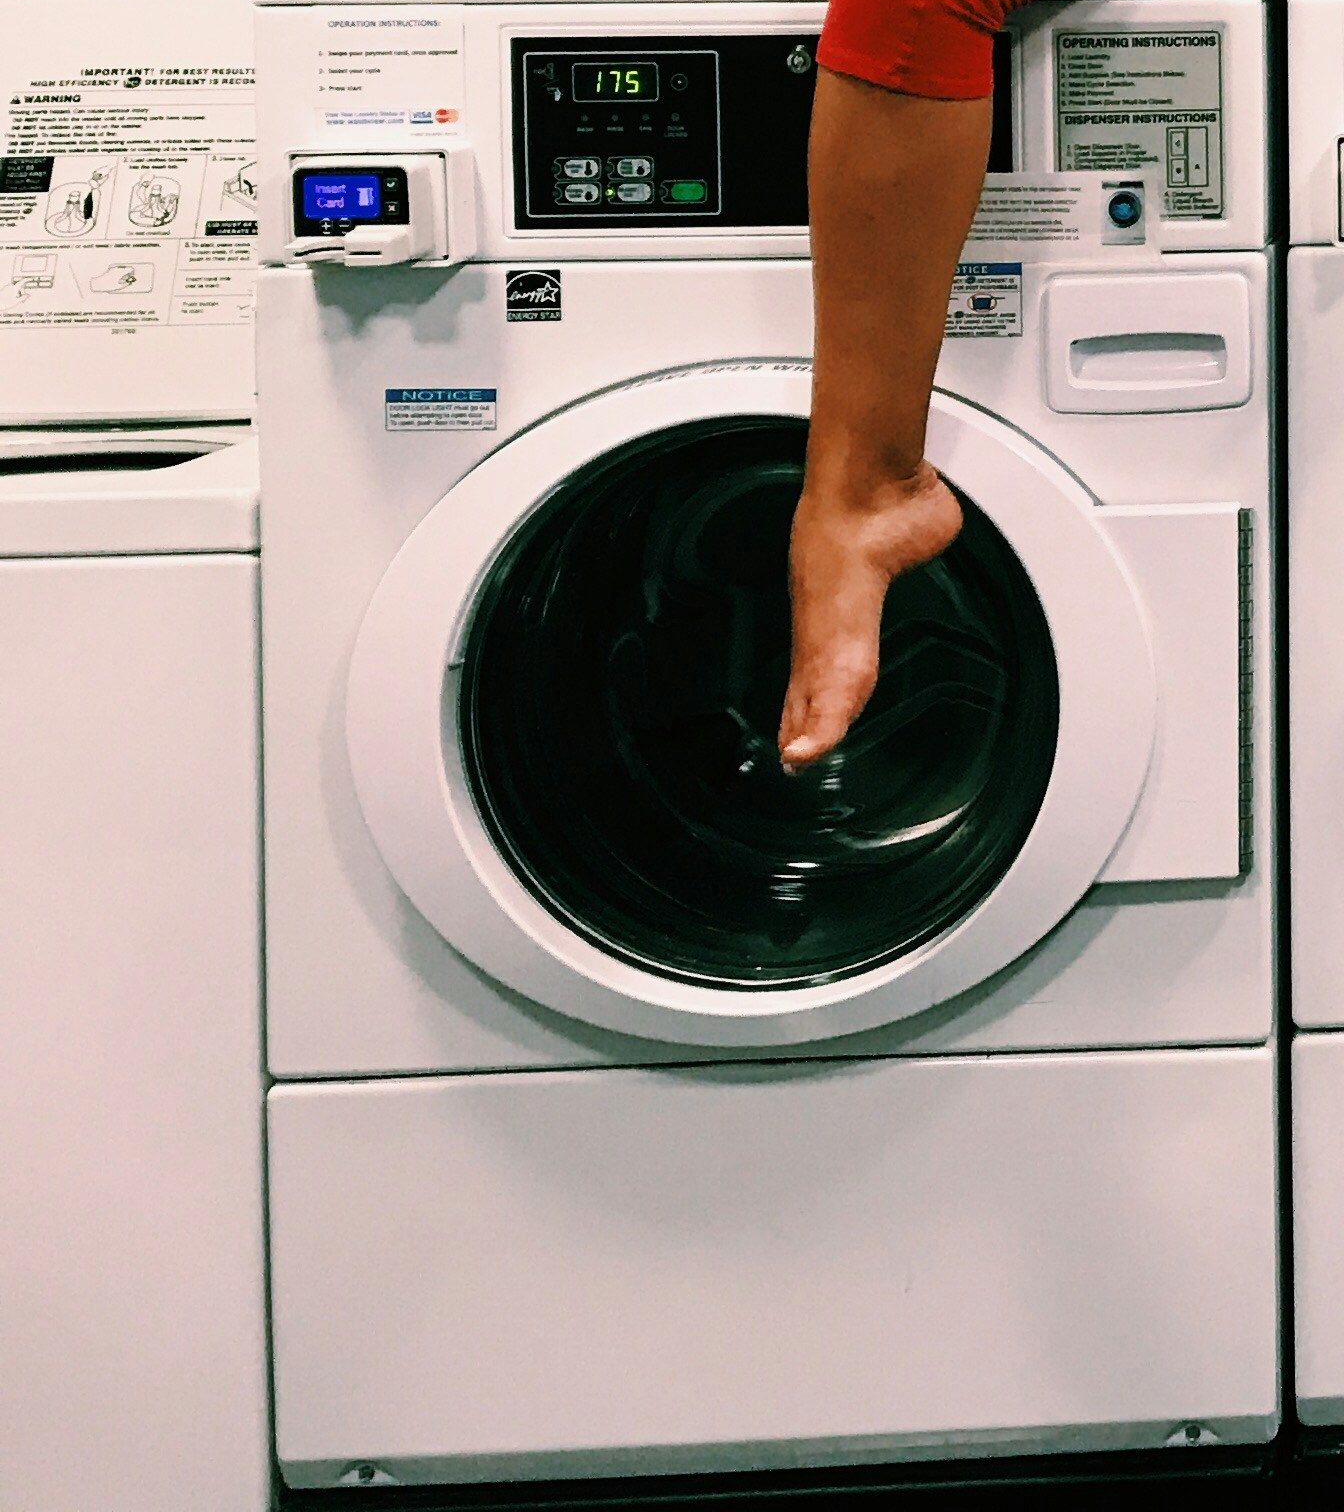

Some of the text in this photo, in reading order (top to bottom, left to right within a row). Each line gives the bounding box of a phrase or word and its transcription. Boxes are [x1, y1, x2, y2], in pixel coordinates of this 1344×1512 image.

[1063, 36, 1216, 49] OPERATING INSTRUCTIONS
[59, 79, 119, 87] EFFICIENCY
[595, 70, 640, 94] 175
[24, 95, 81, 103] WARNING
[1065, 113, 1217, 125] DISPENSER INSTRUCTIONS
[315, 184, 346, 194] Insert
[317, 197, 344, 208] Card
[402, 391, 482, 401] NOTICE
